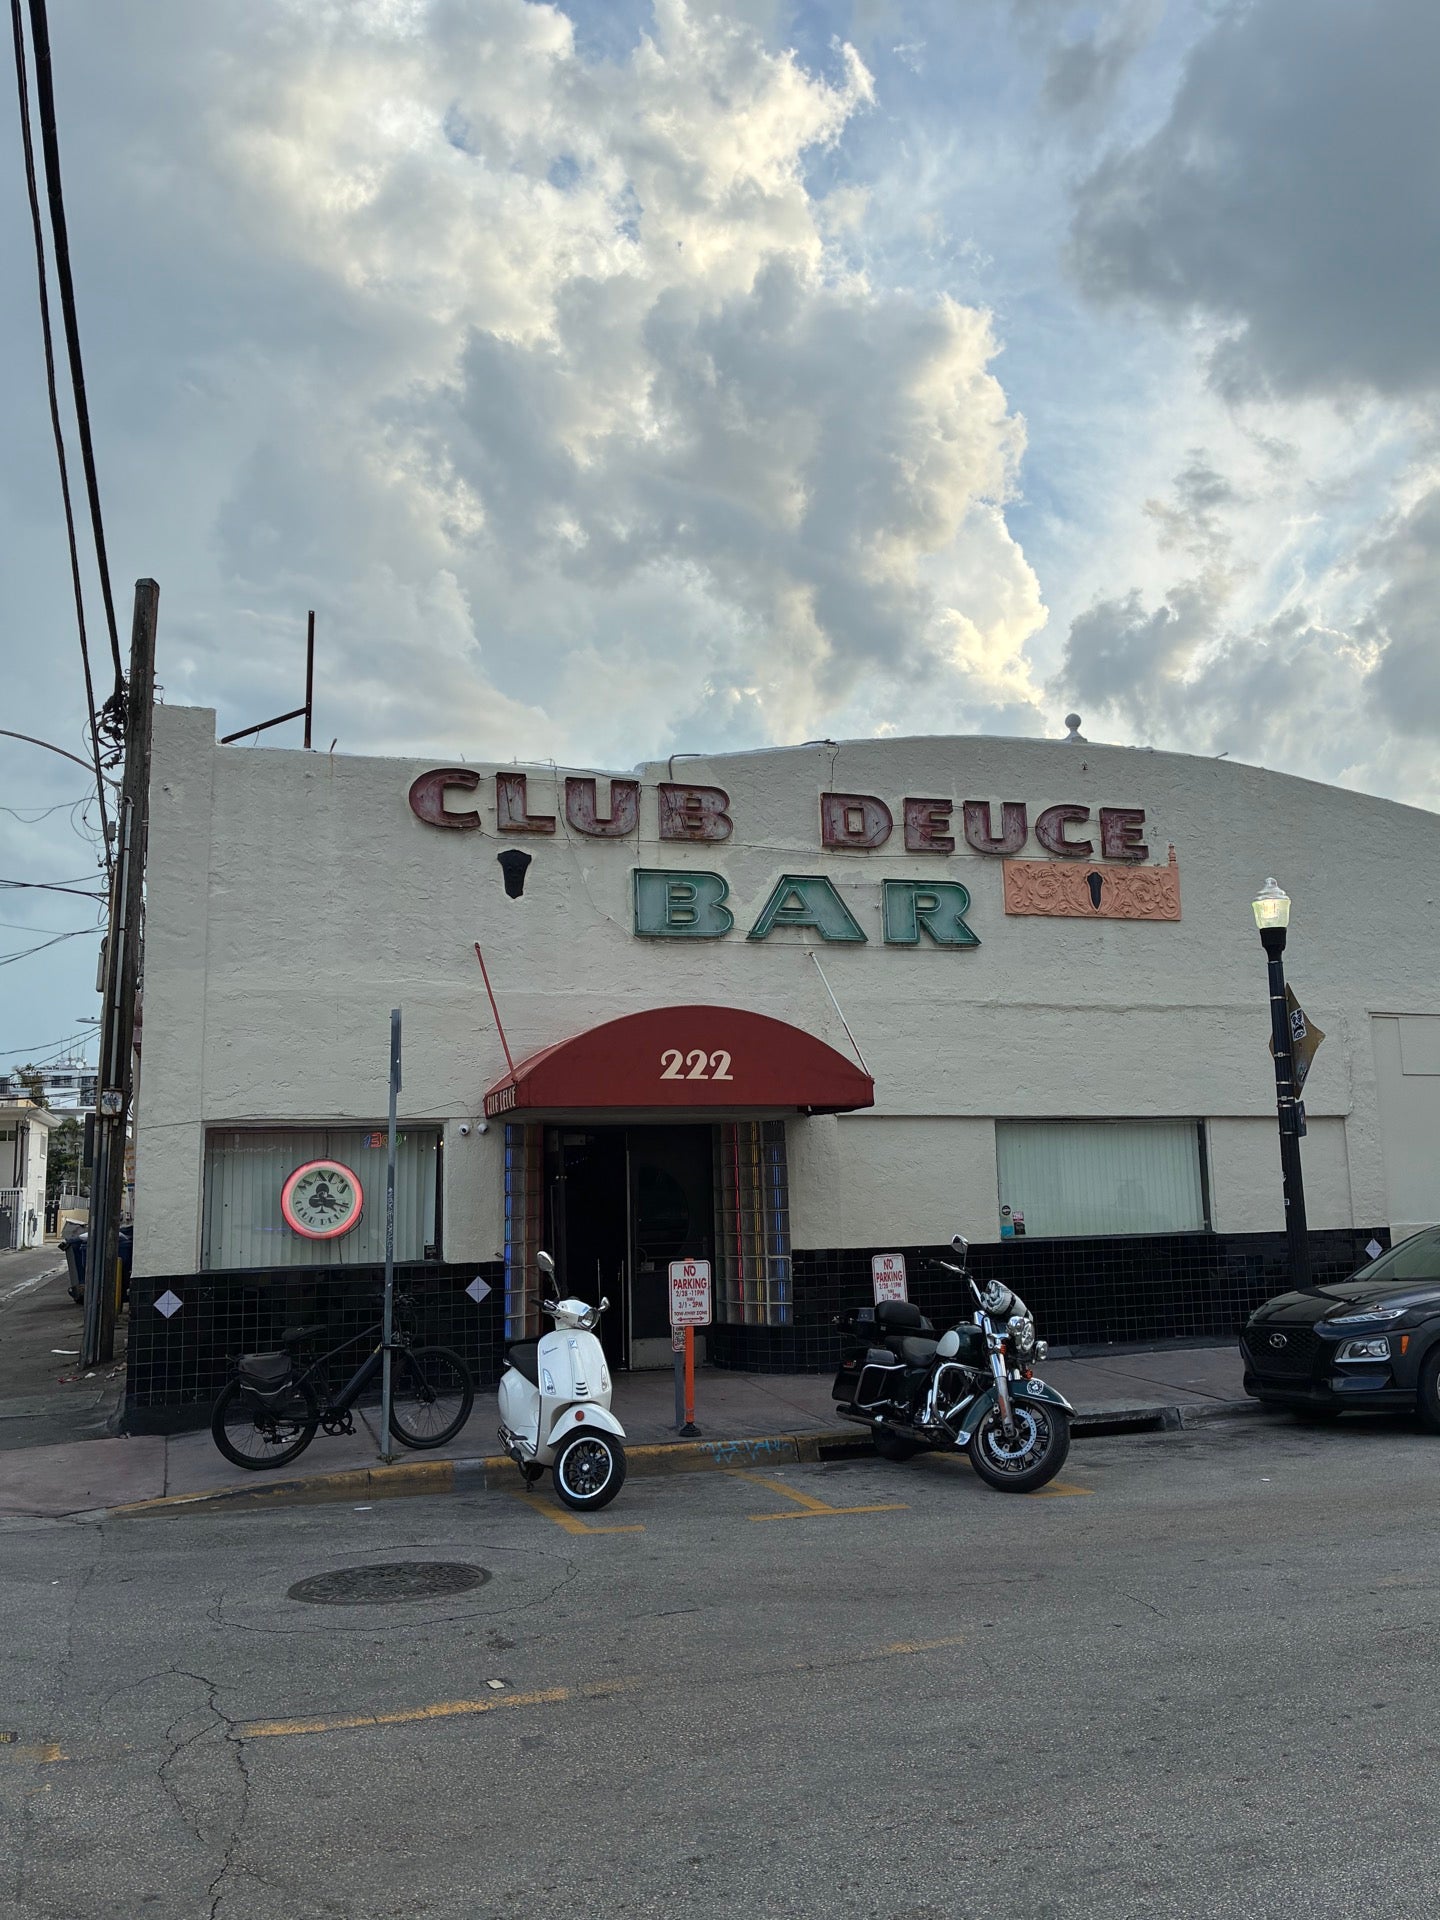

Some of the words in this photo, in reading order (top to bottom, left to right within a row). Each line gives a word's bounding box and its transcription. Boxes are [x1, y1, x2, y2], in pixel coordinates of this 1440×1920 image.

[409, 768, 734, 842] CLUB
[820, 792, 1150, 860] DEUCE
[632, 868, 982, 947] BAR
[659, 1049, 734, 1080] 222
[297, 1171, 350, 1195] MAC'S
[684, 1265, 696, 1276] NO
[884, 1258, 893, 1270] NO
[673, 1278, 707, 1290] PARKING
[876, 1271, 902, 1282] PARKING
